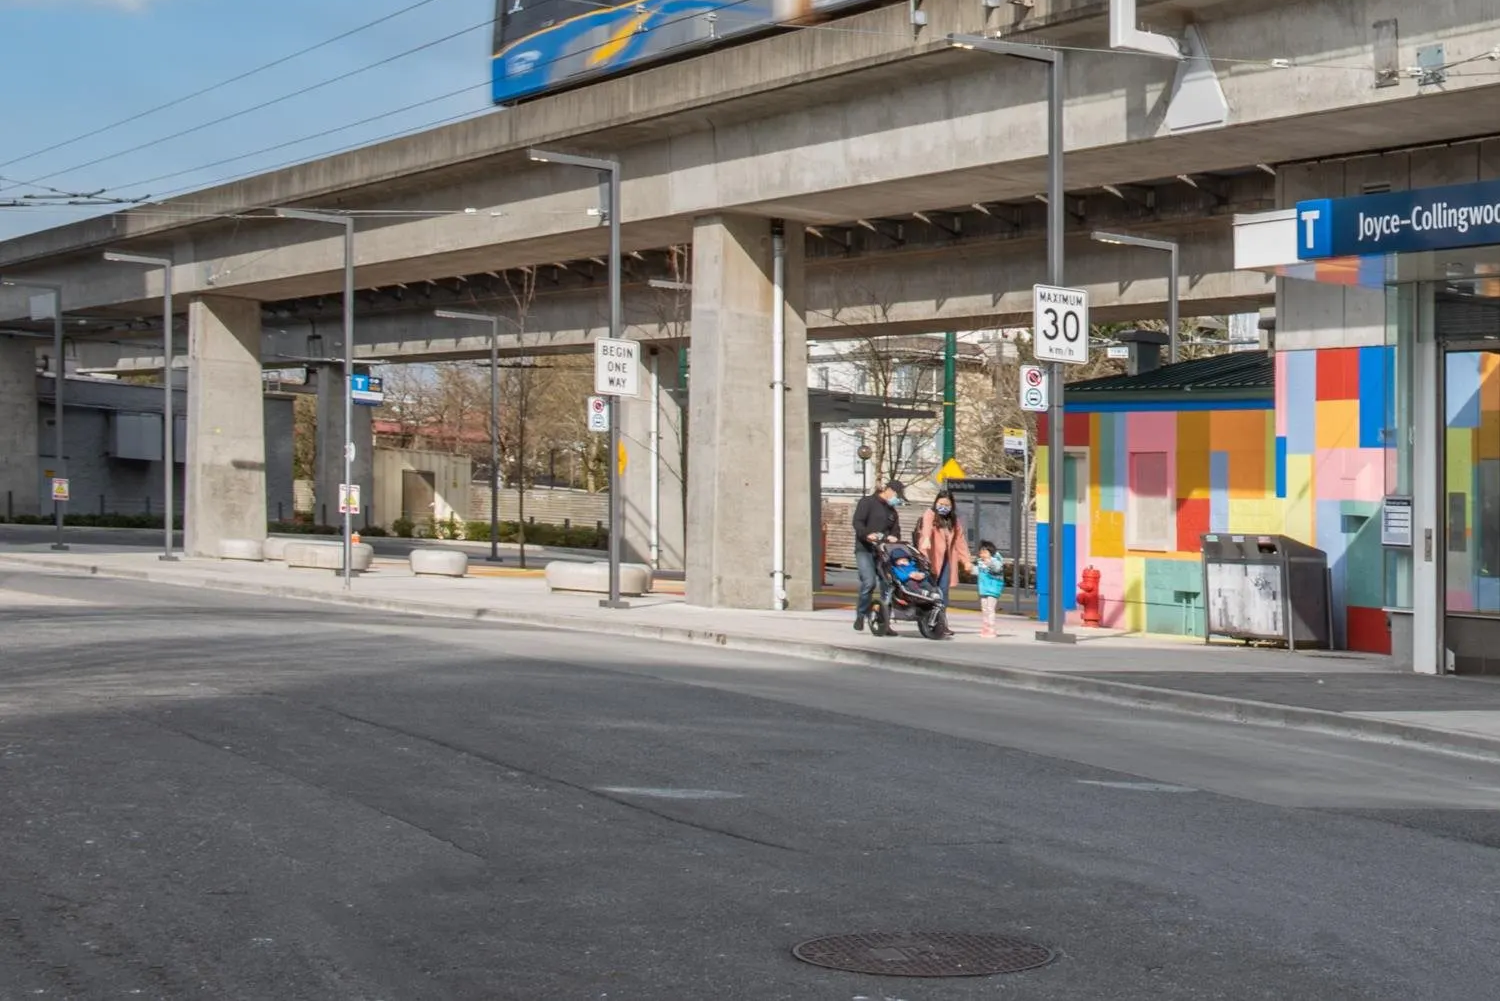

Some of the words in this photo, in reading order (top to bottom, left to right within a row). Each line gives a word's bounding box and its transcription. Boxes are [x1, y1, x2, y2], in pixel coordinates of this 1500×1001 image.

[1301, 210, 1320, 248] T
[1040, 292, 1082, 306] MAXIMUM
[1043, 308, 1080, 342] 30
[602, 345, 633, 358] BEGIN
[1049, 346, 1074, 356] km/h
[608, 361, 627, 373] ONE
[355, 377, 365, 389] T
[609, 377, 627, 388] WAY
